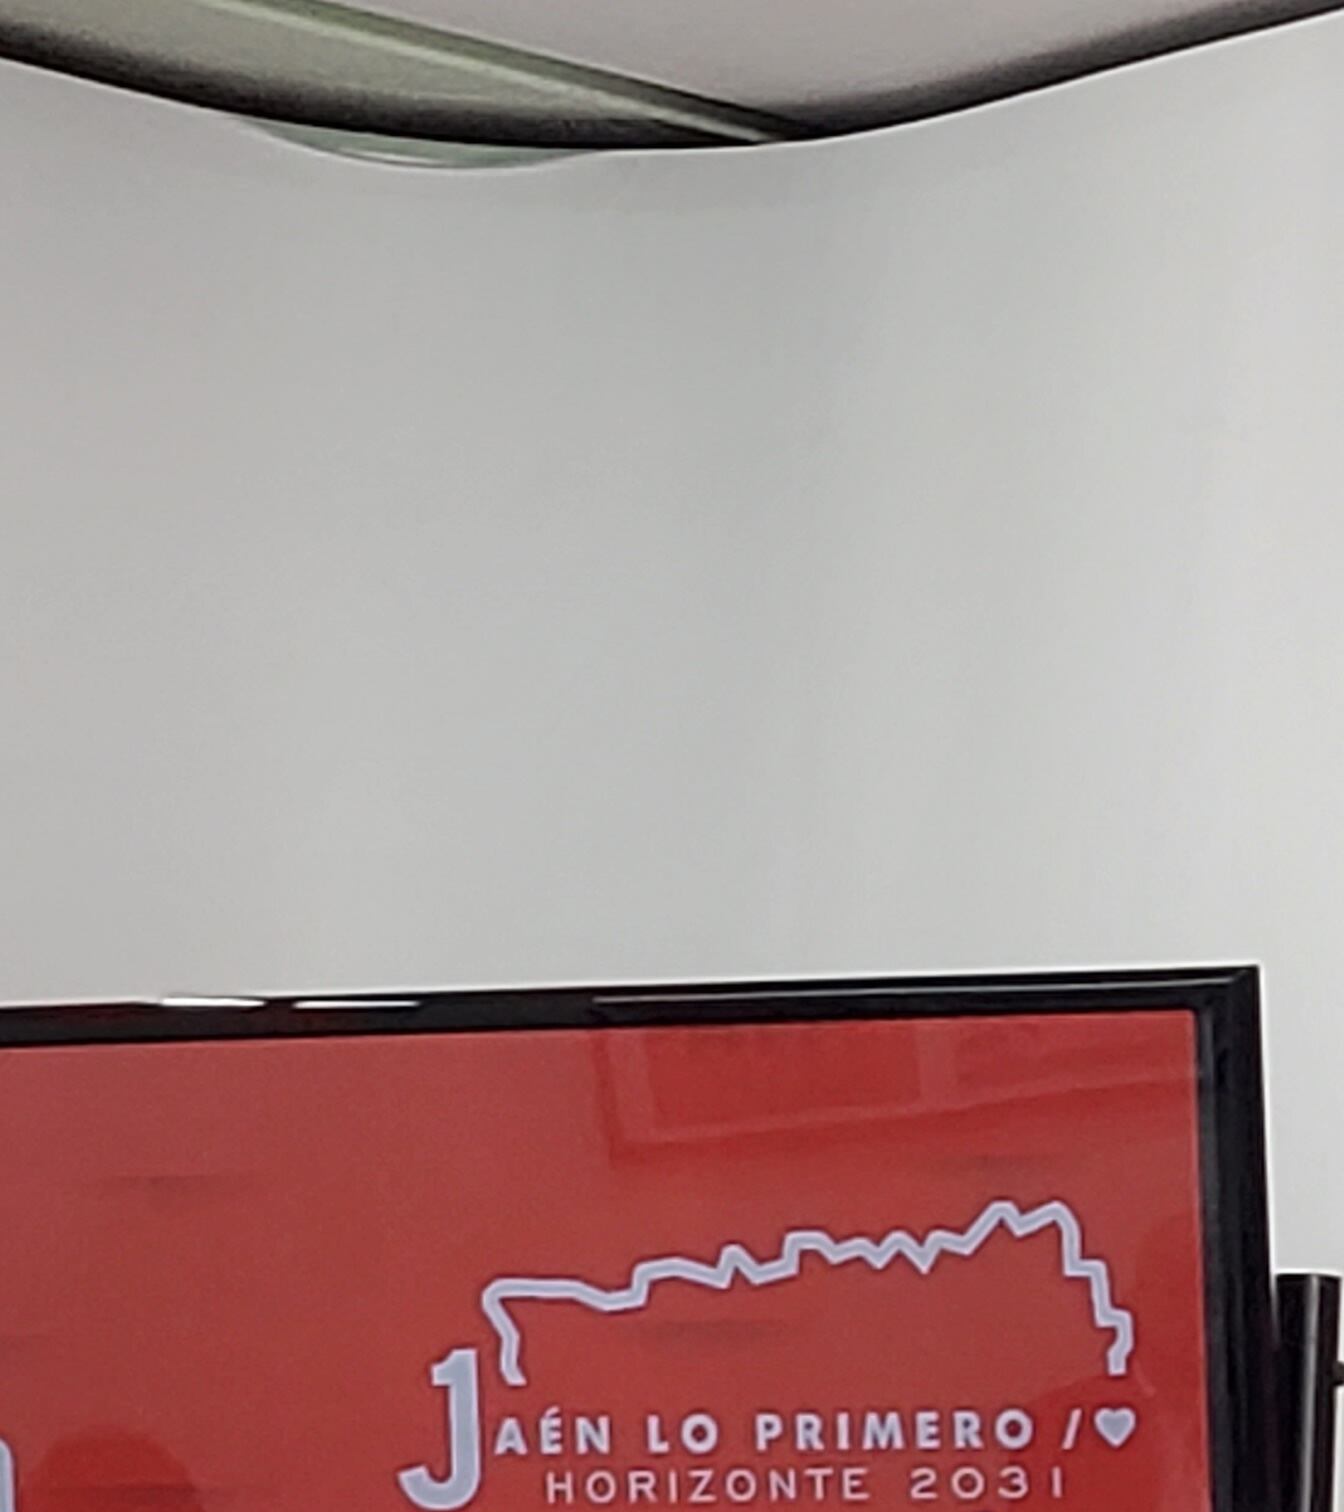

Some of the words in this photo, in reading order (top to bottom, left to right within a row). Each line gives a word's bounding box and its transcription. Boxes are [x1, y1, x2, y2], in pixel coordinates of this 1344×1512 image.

[647, 1412, 719, 1454] LO
[755, 1409, 1034, 1453] PRIMERO
[546, 1468, 871, 1504] HORIZONTE
[909, 1466, 1065, 1500] 2031
